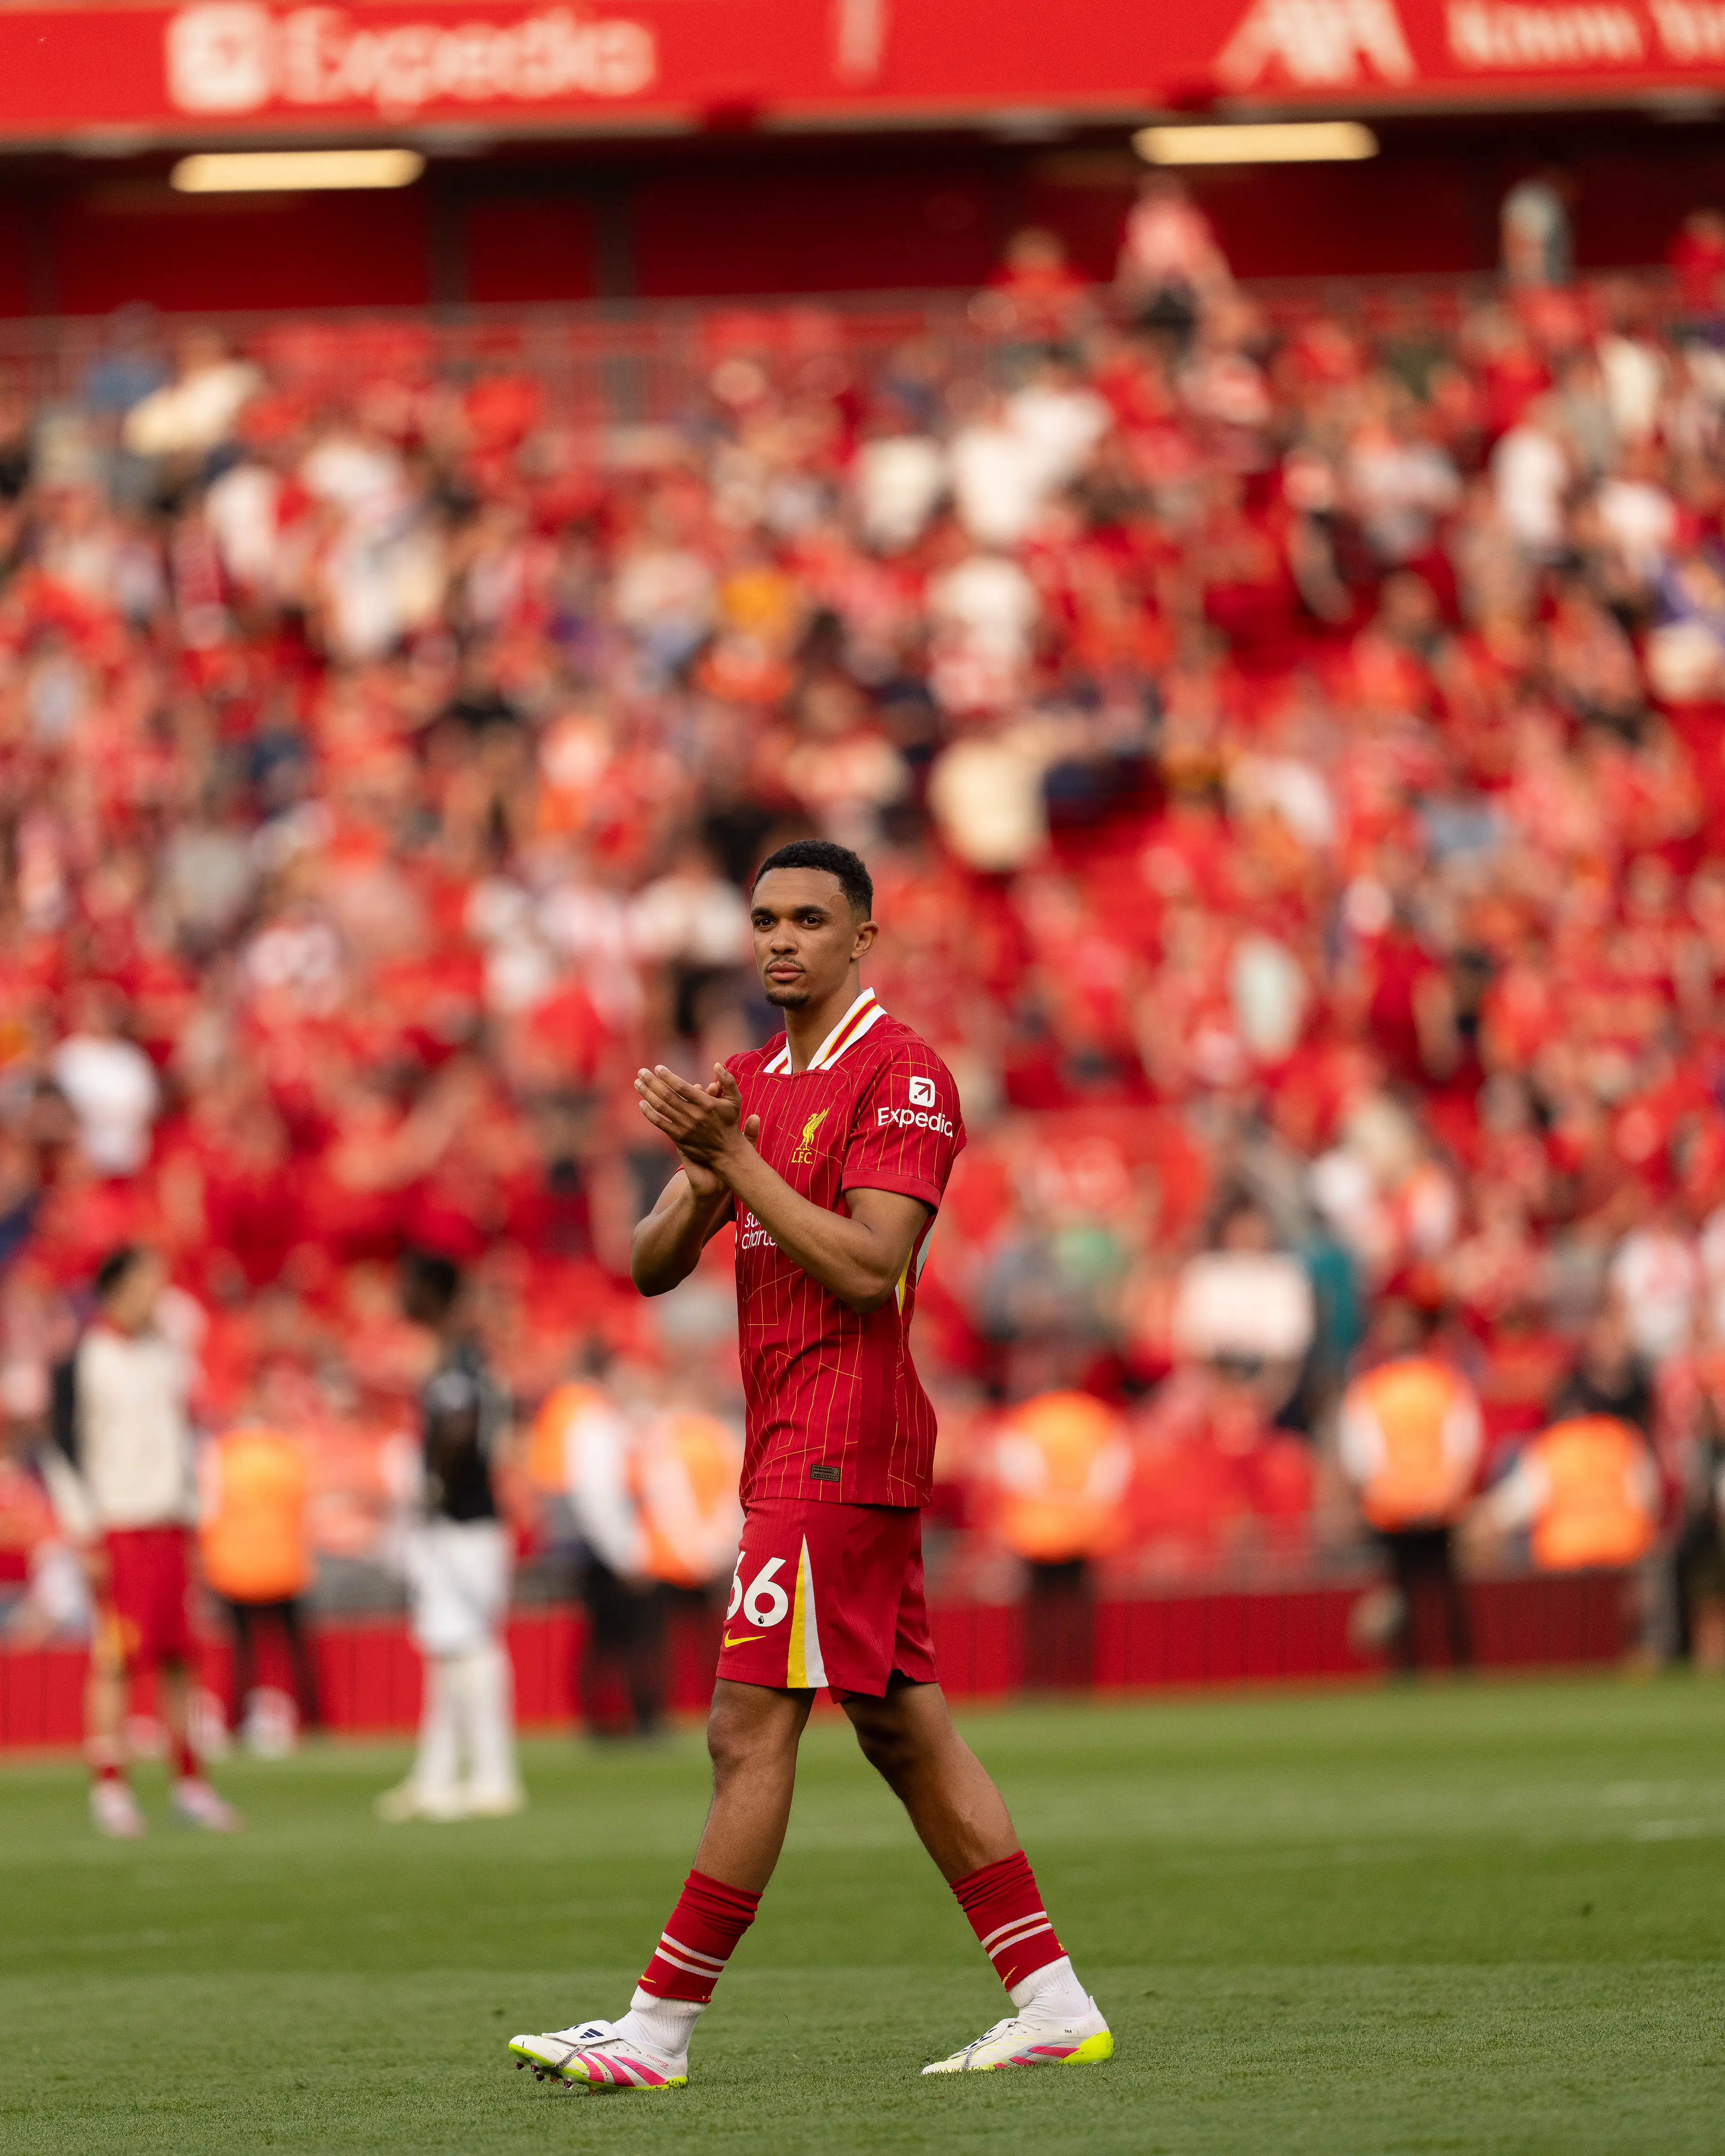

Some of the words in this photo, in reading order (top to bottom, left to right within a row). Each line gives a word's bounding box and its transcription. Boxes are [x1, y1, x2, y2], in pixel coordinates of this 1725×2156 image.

[878, 1107, 953, 1137] Expedia
[742, 1229, 776, 1249] charte
[646, 2054, 669, 2067] PREDATOR
